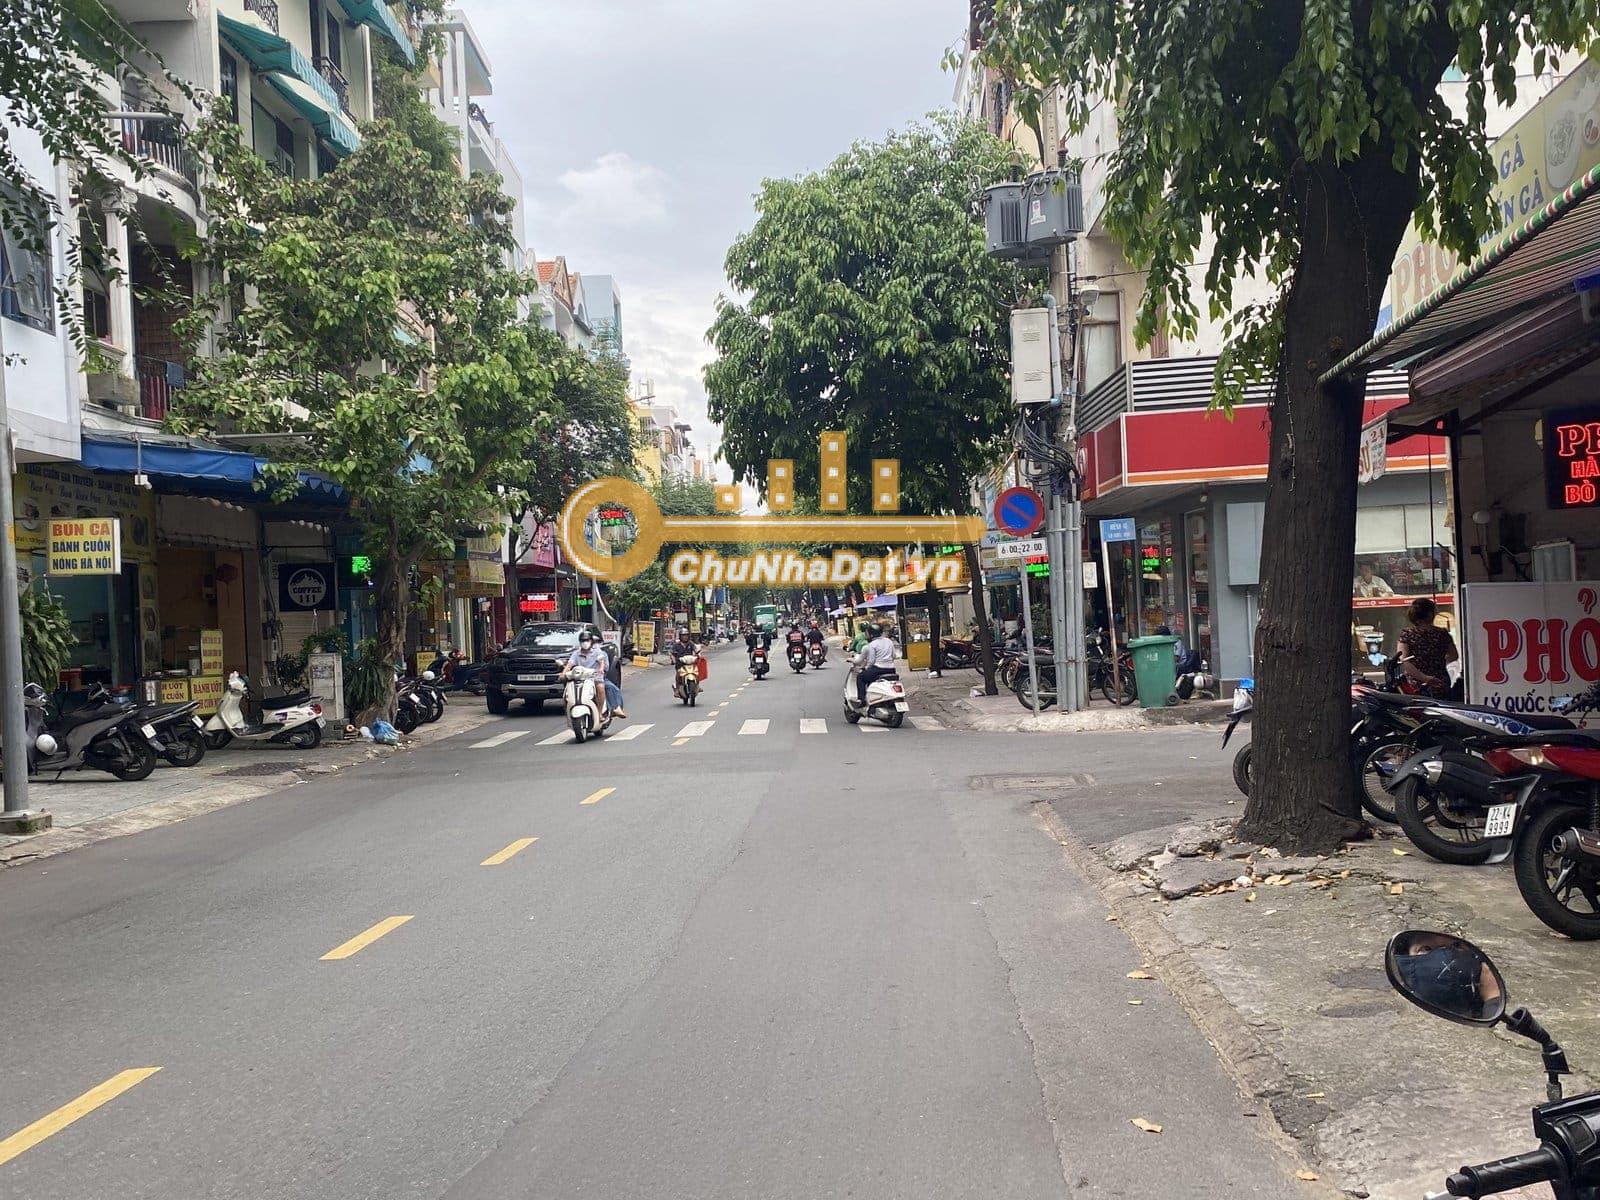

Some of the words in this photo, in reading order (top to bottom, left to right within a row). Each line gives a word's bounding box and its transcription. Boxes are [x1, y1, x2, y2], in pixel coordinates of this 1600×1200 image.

[1500, 134, 1525, 180] GÀ
[1519, 169, 1544, 215] GÀ
[1565, 480, 1596, 504] BÒ
[83, 538, 111, 552] CUỐN
[1505, 689, 1546, 714] QUỐC
[1487, 821, 1509, 836] 9999
